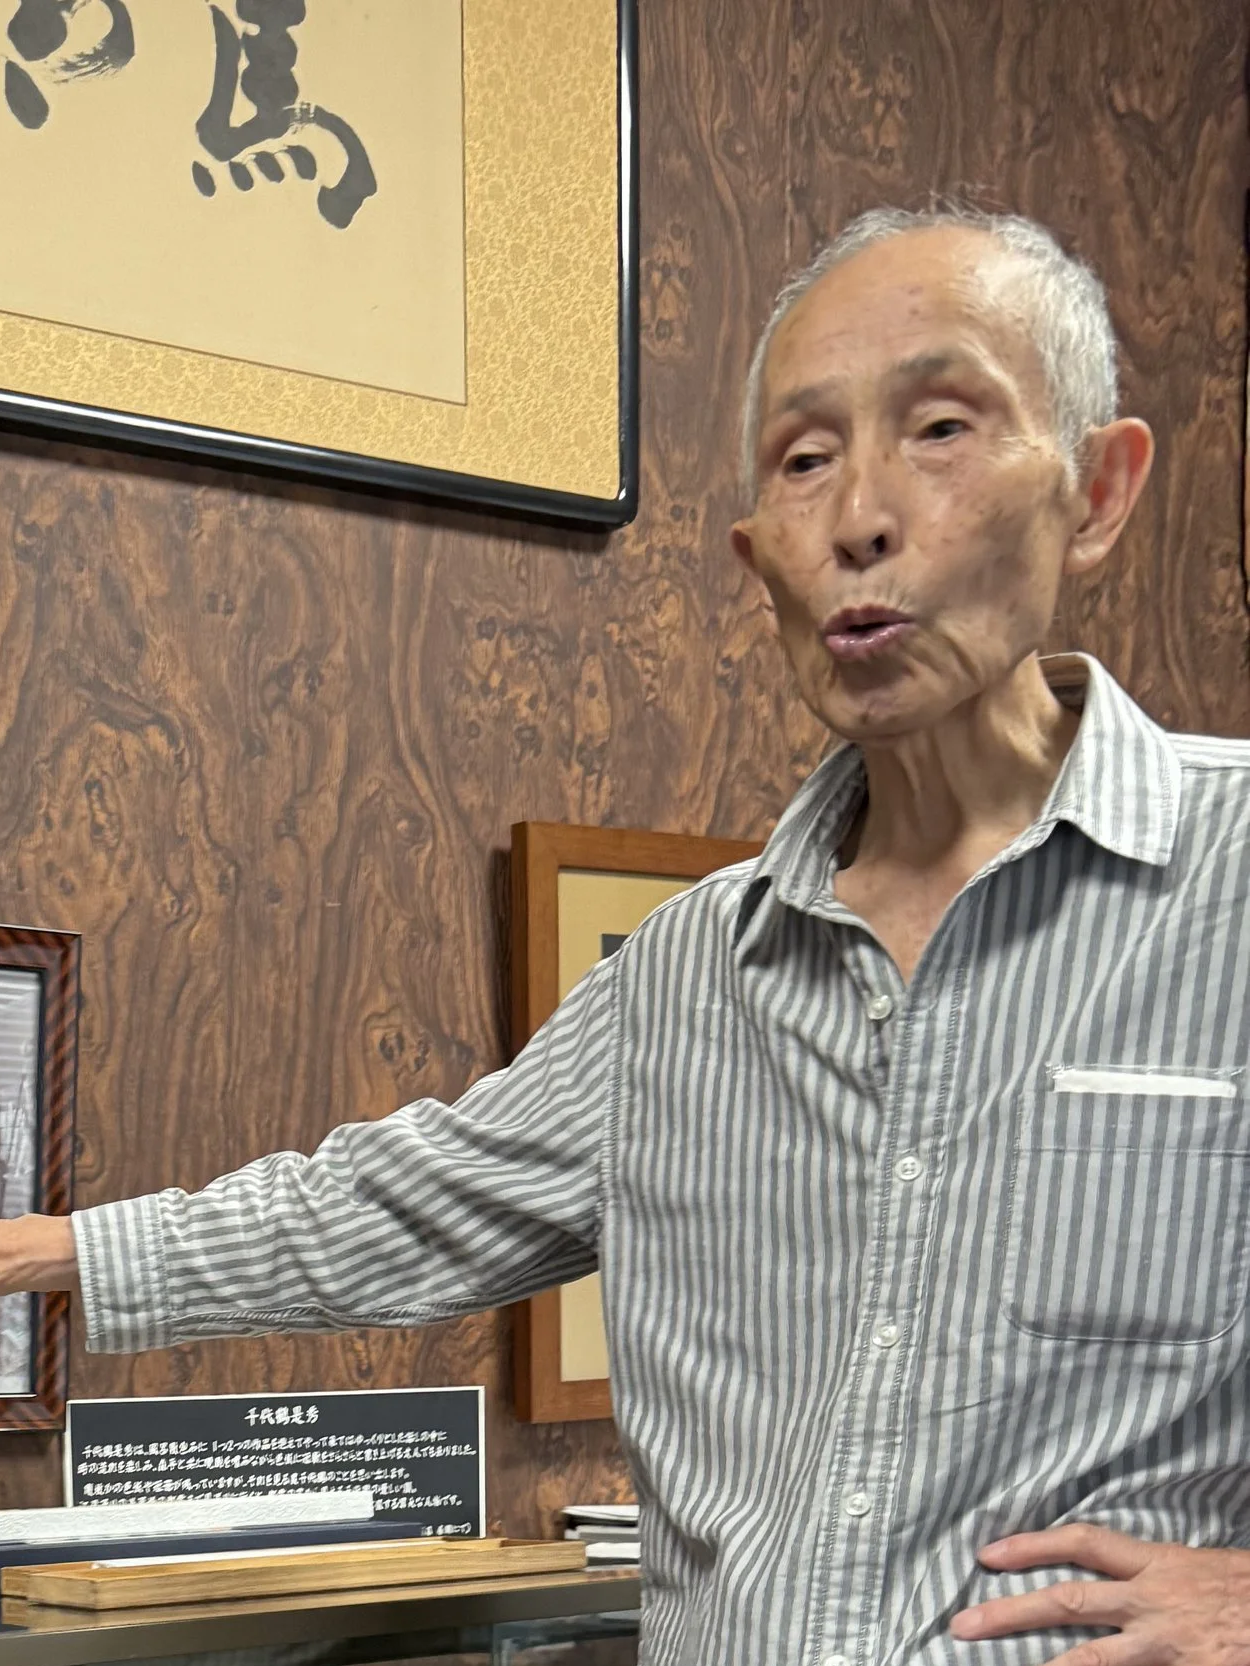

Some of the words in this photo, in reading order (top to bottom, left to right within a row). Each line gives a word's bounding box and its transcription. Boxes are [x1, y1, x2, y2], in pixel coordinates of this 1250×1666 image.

[244, 1404, 320, 1427] 千代鶴是秀
